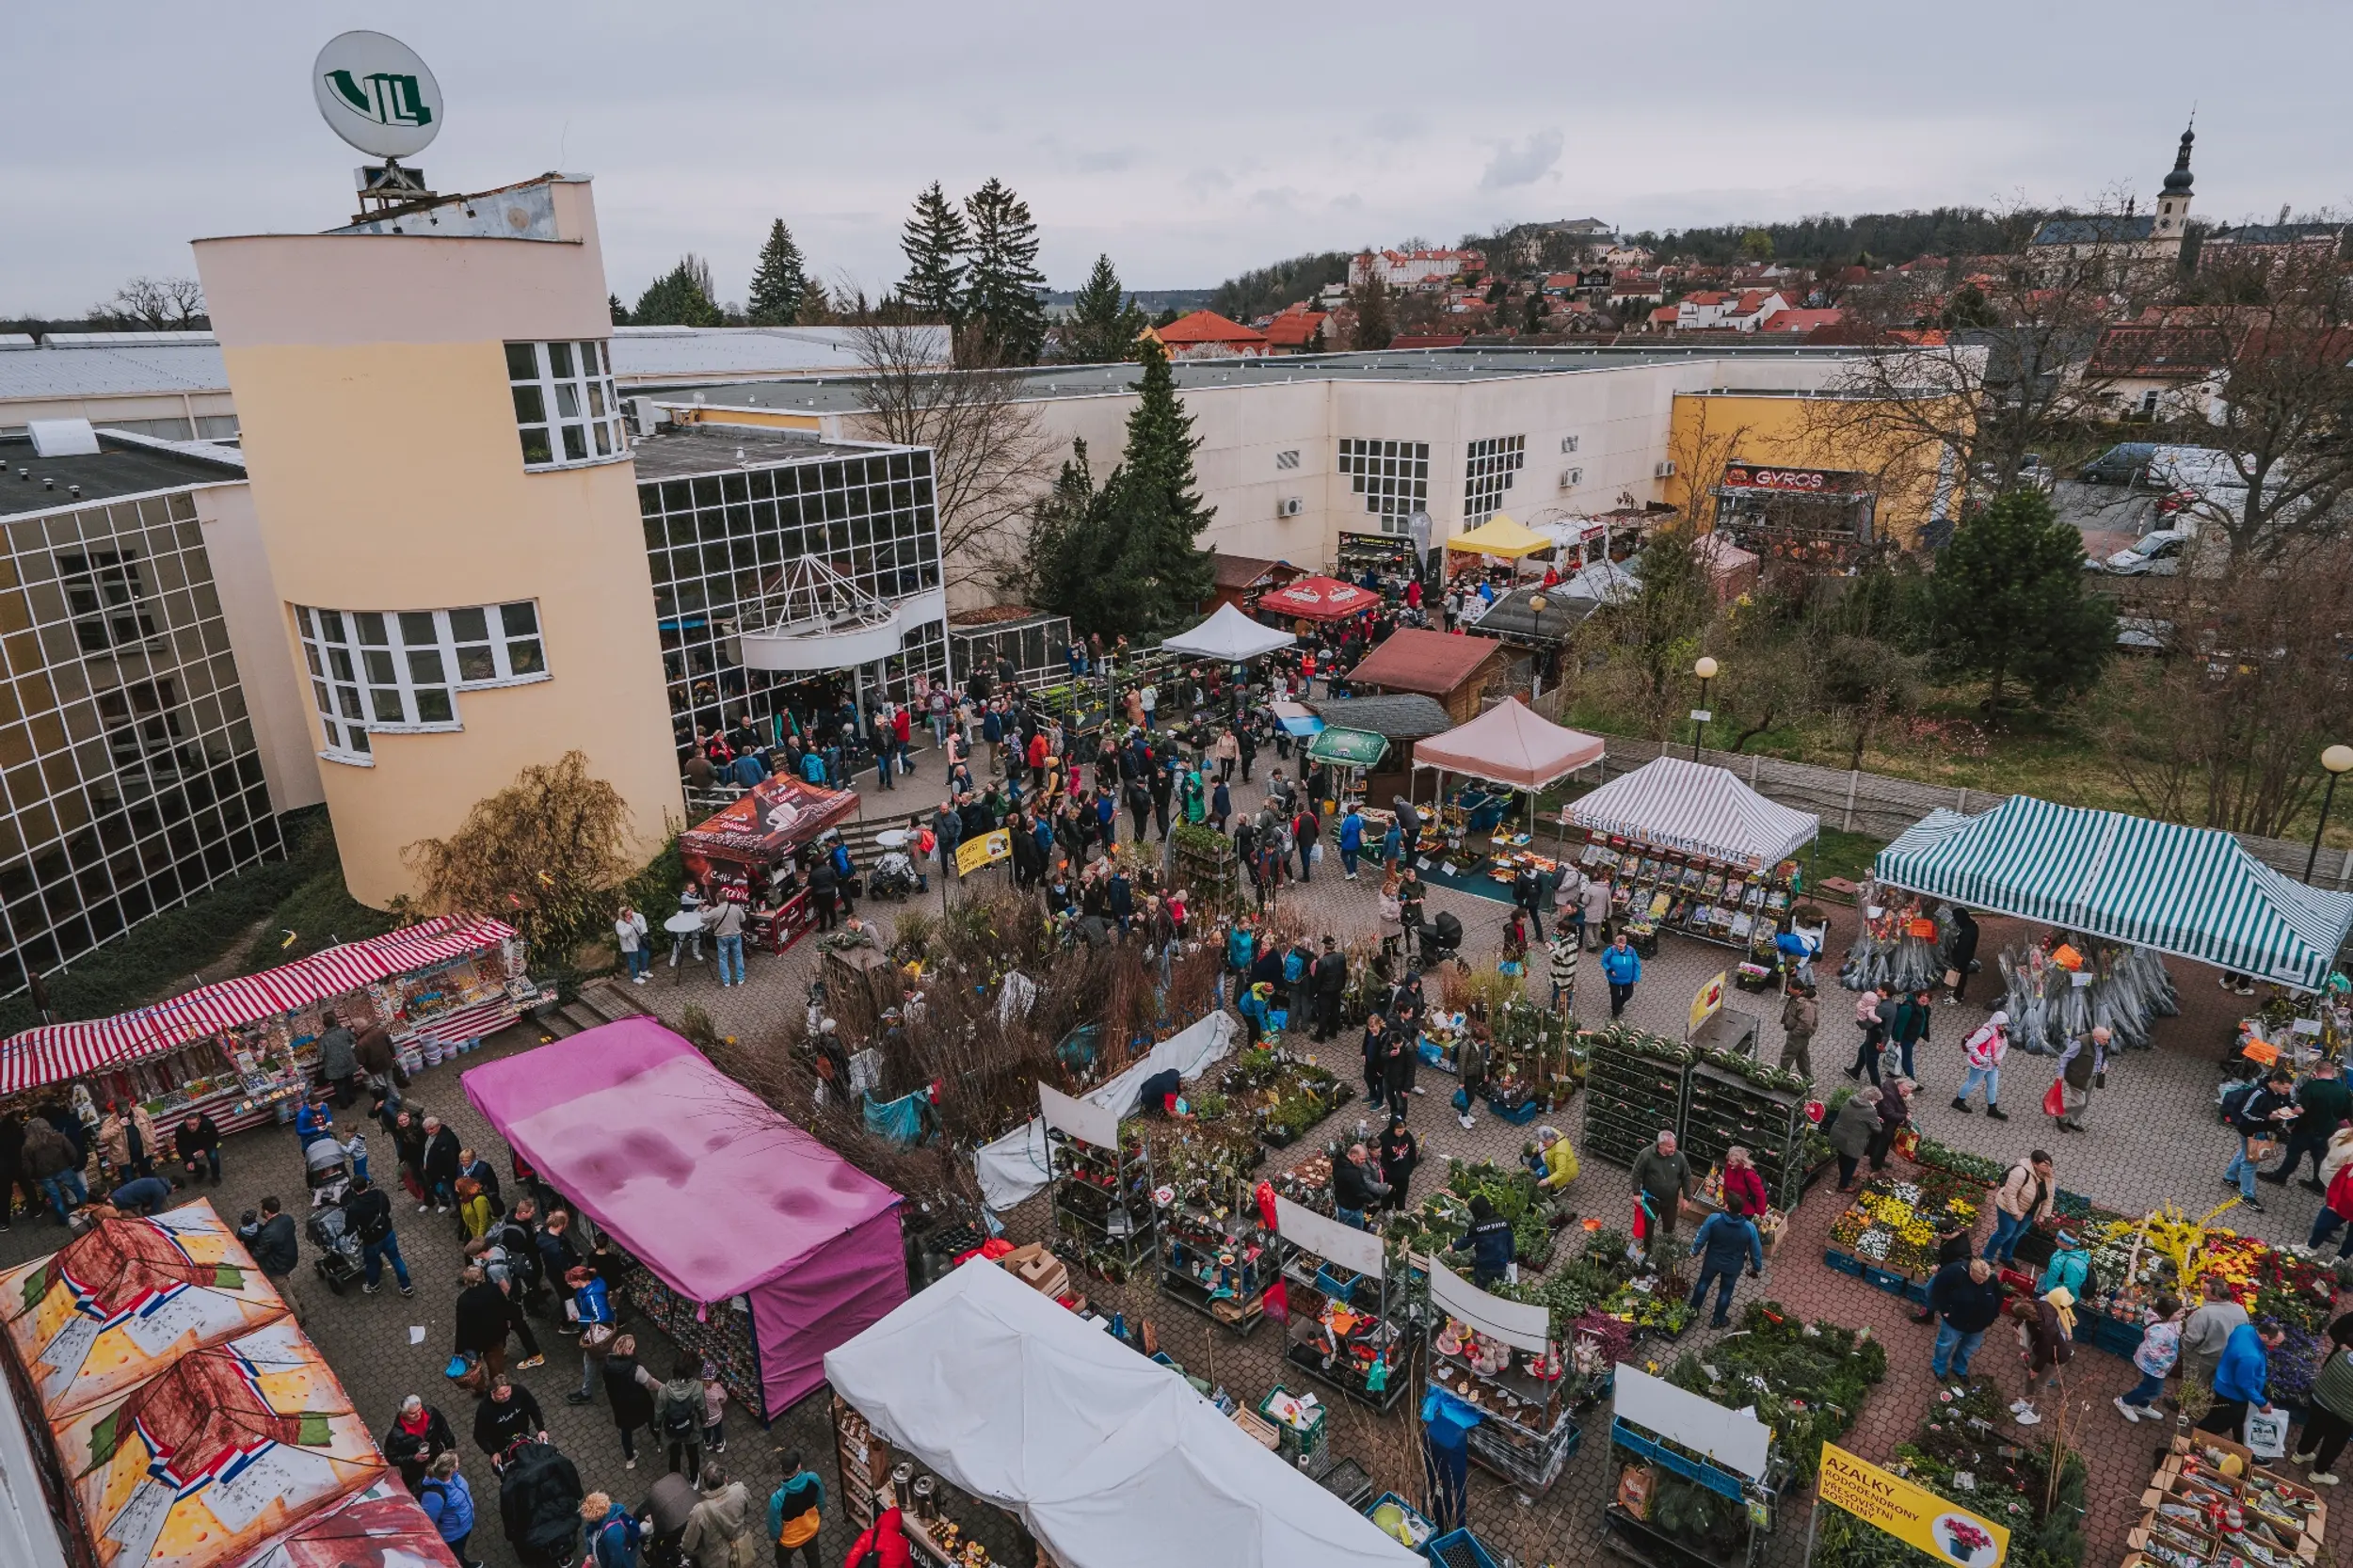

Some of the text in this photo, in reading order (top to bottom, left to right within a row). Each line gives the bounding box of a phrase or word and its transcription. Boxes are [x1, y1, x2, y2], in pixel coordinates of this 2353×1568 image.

[1755, 470, 1824, 488] GYROS
[1573, 812, 1749, 865] CEBULKI KWIATOWE
[1824, 1469, 1920, 1521] RODODENDRONY
[1826, 1457, 1895, 1496] AZALKY
[1822, 1487, 1875, 1519] ROSTLINY
